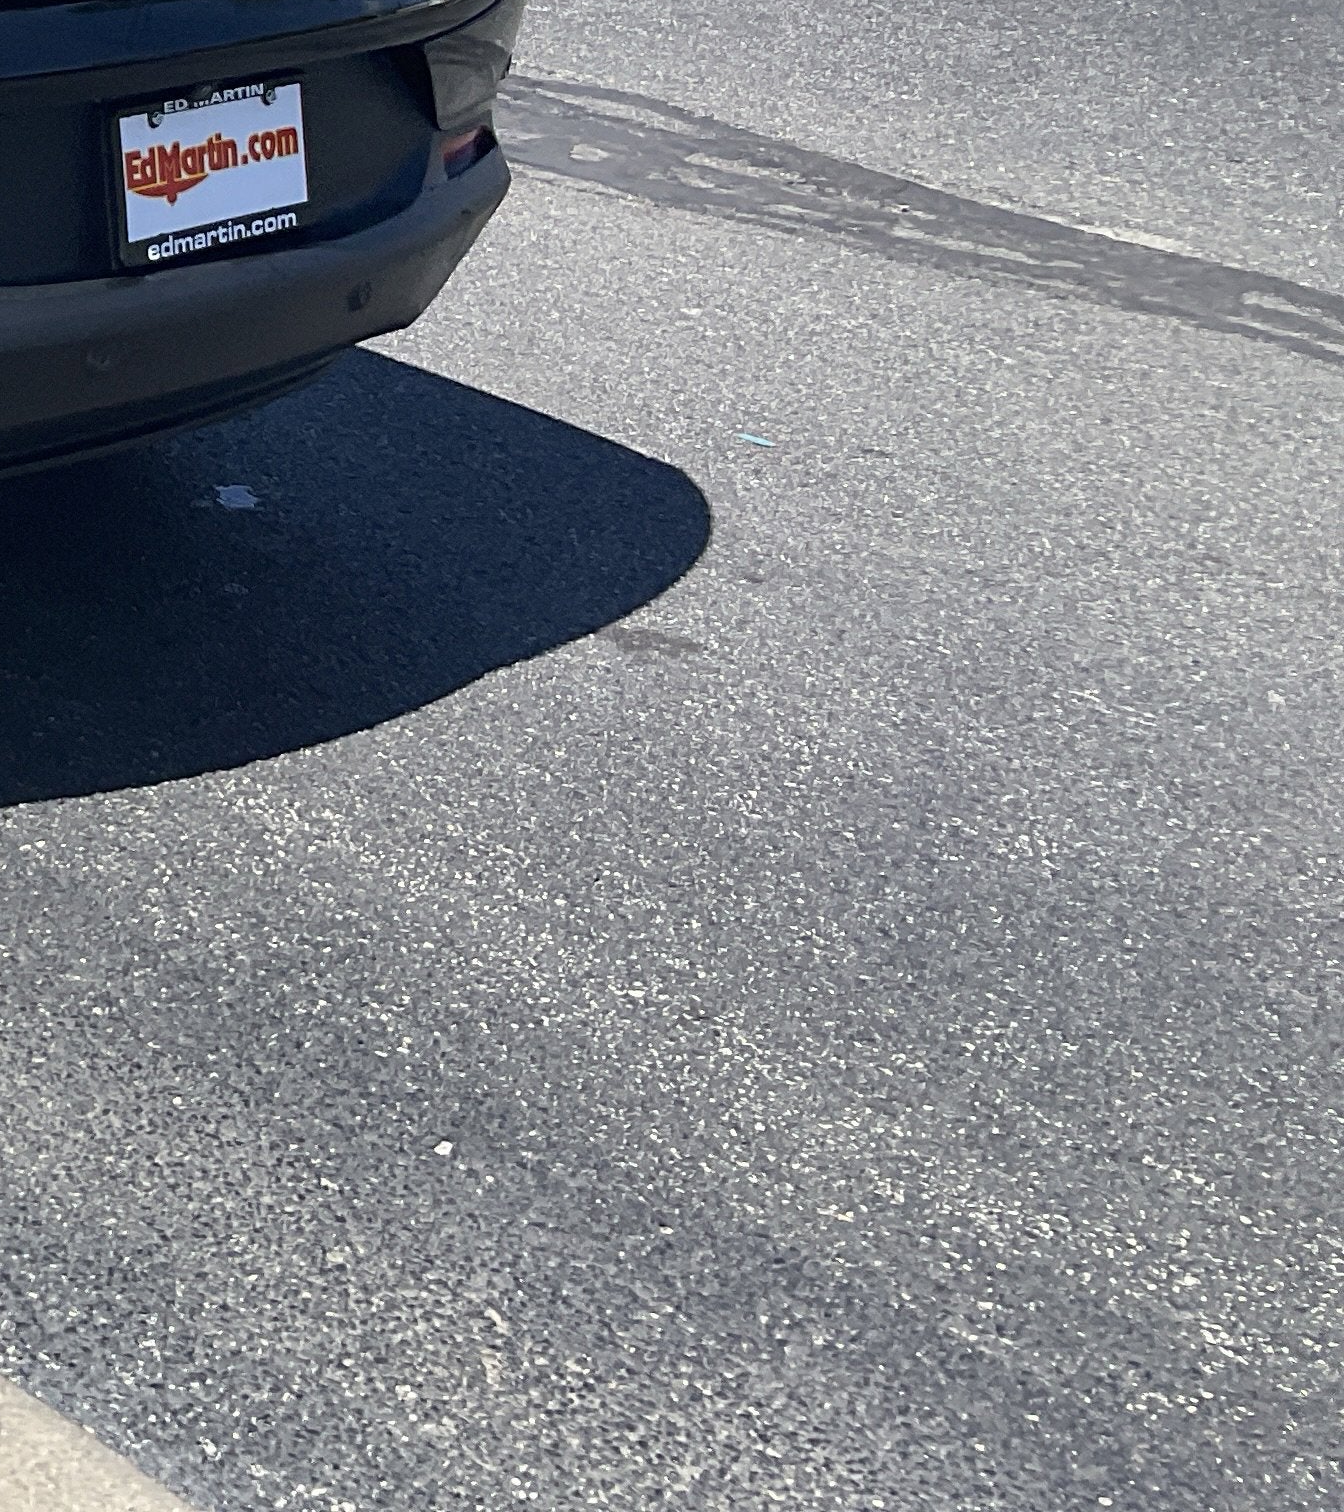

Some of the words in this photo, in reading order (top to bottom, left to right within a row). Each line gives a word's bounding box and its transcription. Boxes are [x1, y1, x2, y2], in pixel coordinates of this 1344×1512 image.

[163, 98, 188, 114] ED
[124, 125, 299, 191] EdMartin.com
[147, 212, 297, 261] edmartin.com
